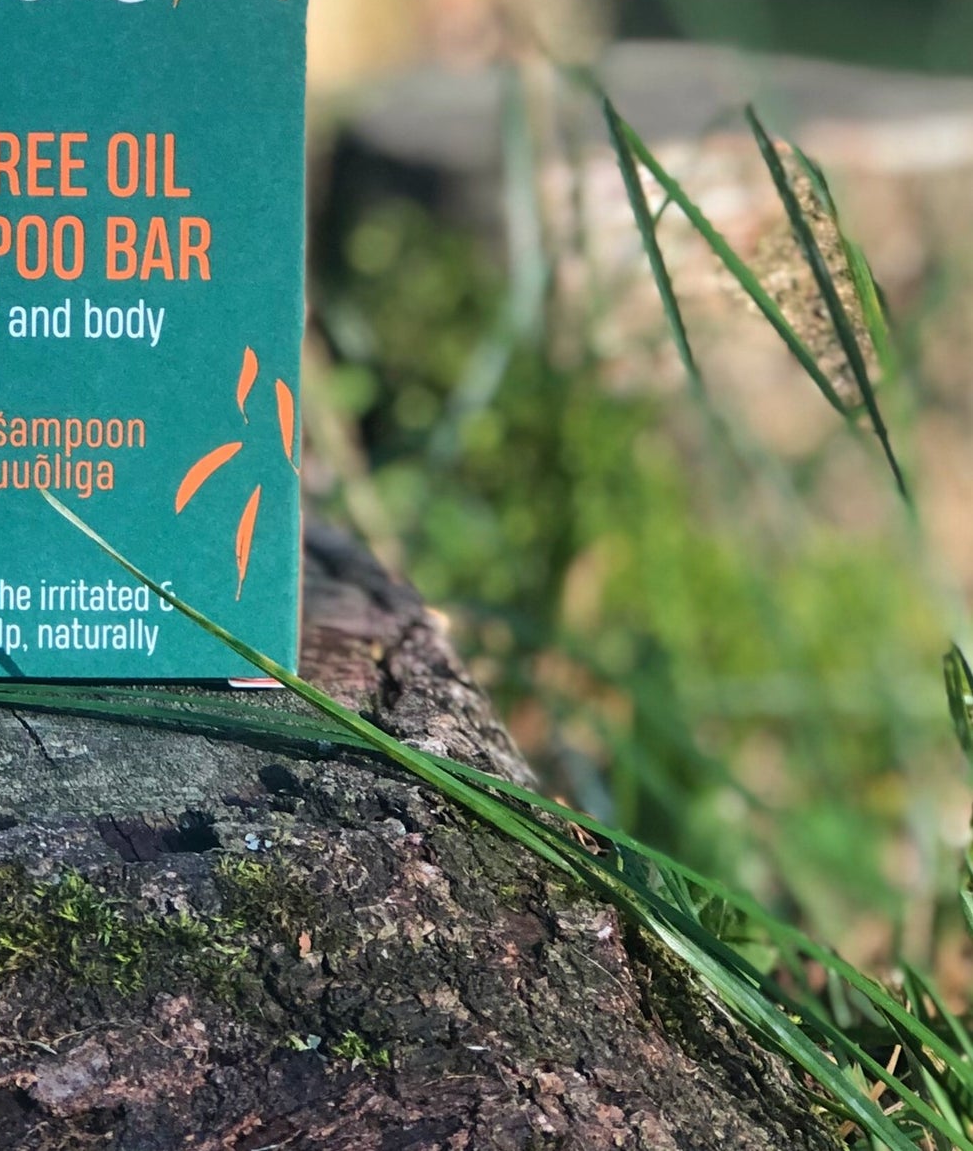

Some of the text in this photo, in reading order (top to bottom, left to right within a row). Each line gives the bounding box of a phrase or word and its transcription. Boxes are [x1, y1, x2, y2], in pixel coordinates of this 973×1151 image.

[107, 132, 191, 197] OIL
[106, 216, 212, 281] BAR
[8, 298, 71, 338] and
[84, 298, 165, 347] body
[40, 579, 149, 612] irritated
[38, 617, 159, 657] naturally
